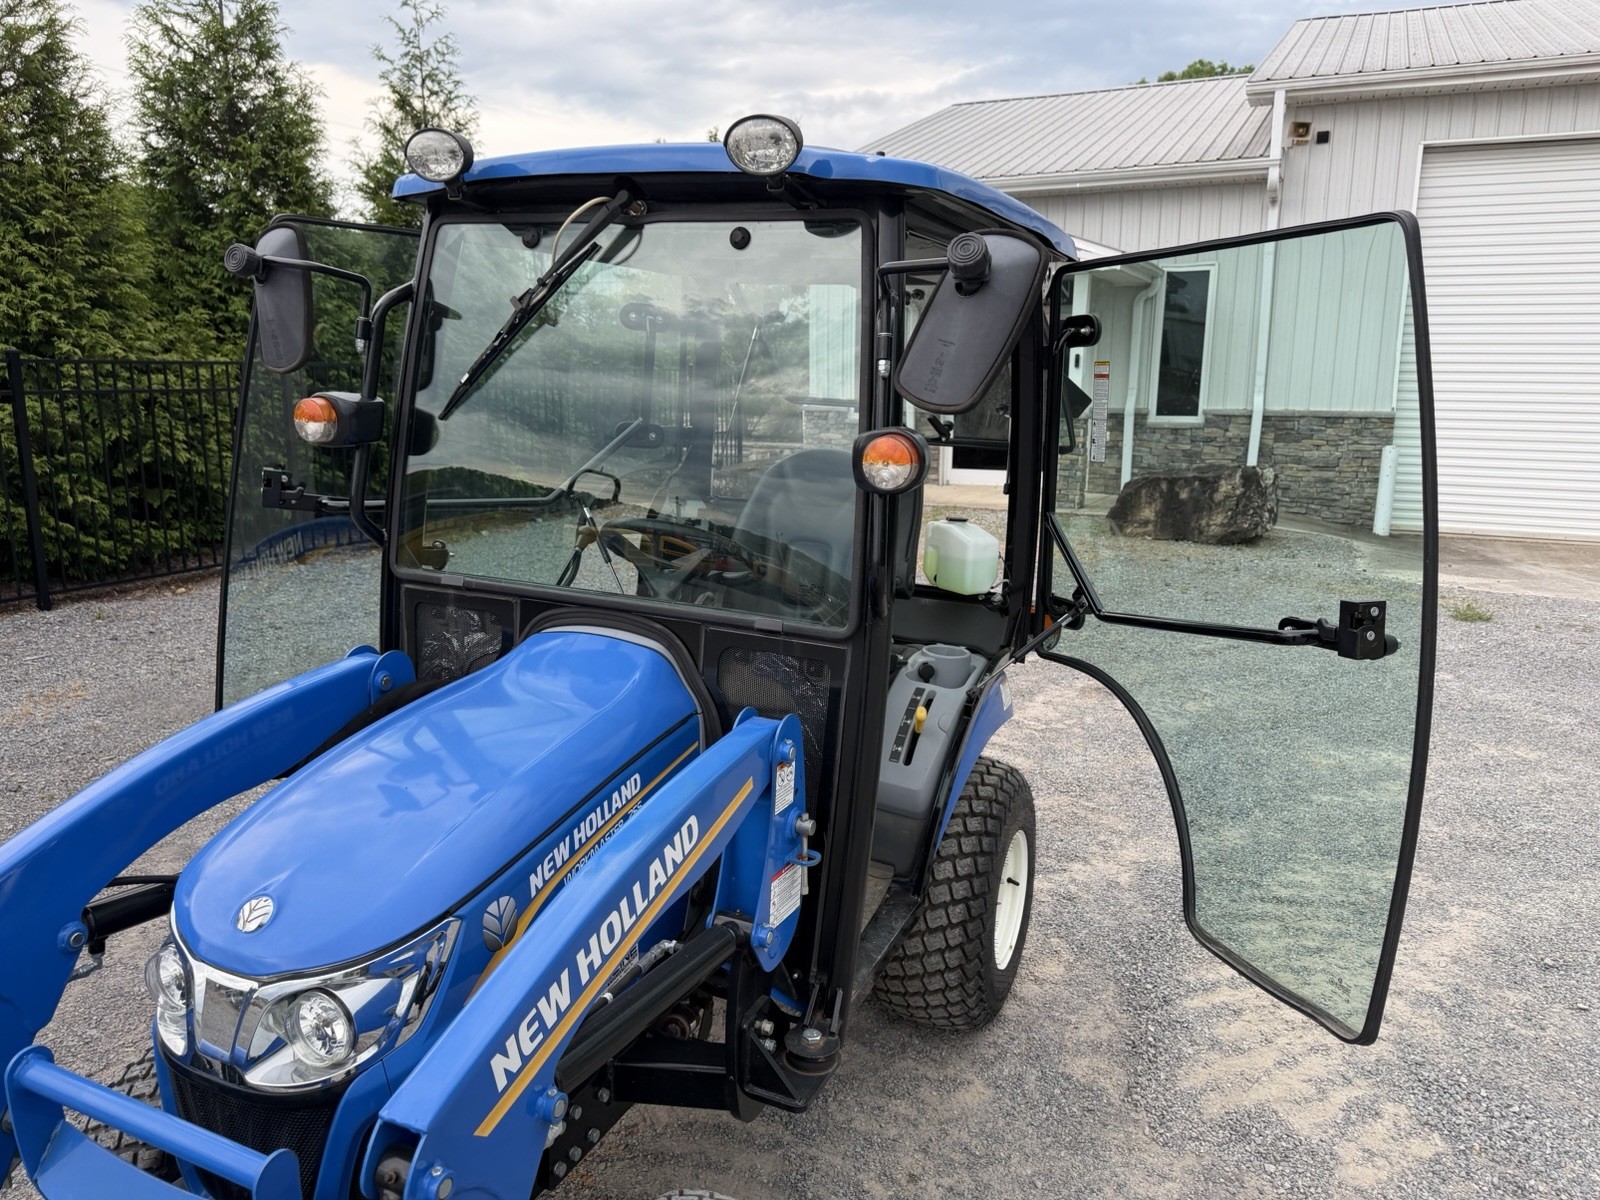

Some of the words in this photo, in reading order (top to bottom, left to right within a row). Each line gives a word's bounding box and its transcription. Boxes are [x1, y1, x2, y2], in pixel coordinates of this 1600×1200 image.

[529, 835, 570, 898] NEW
[573, 772, 641, 850] HOLLAND
[490, 967, 571, 1093] NEW
[576, 815, 699, 986] HOLLAND
